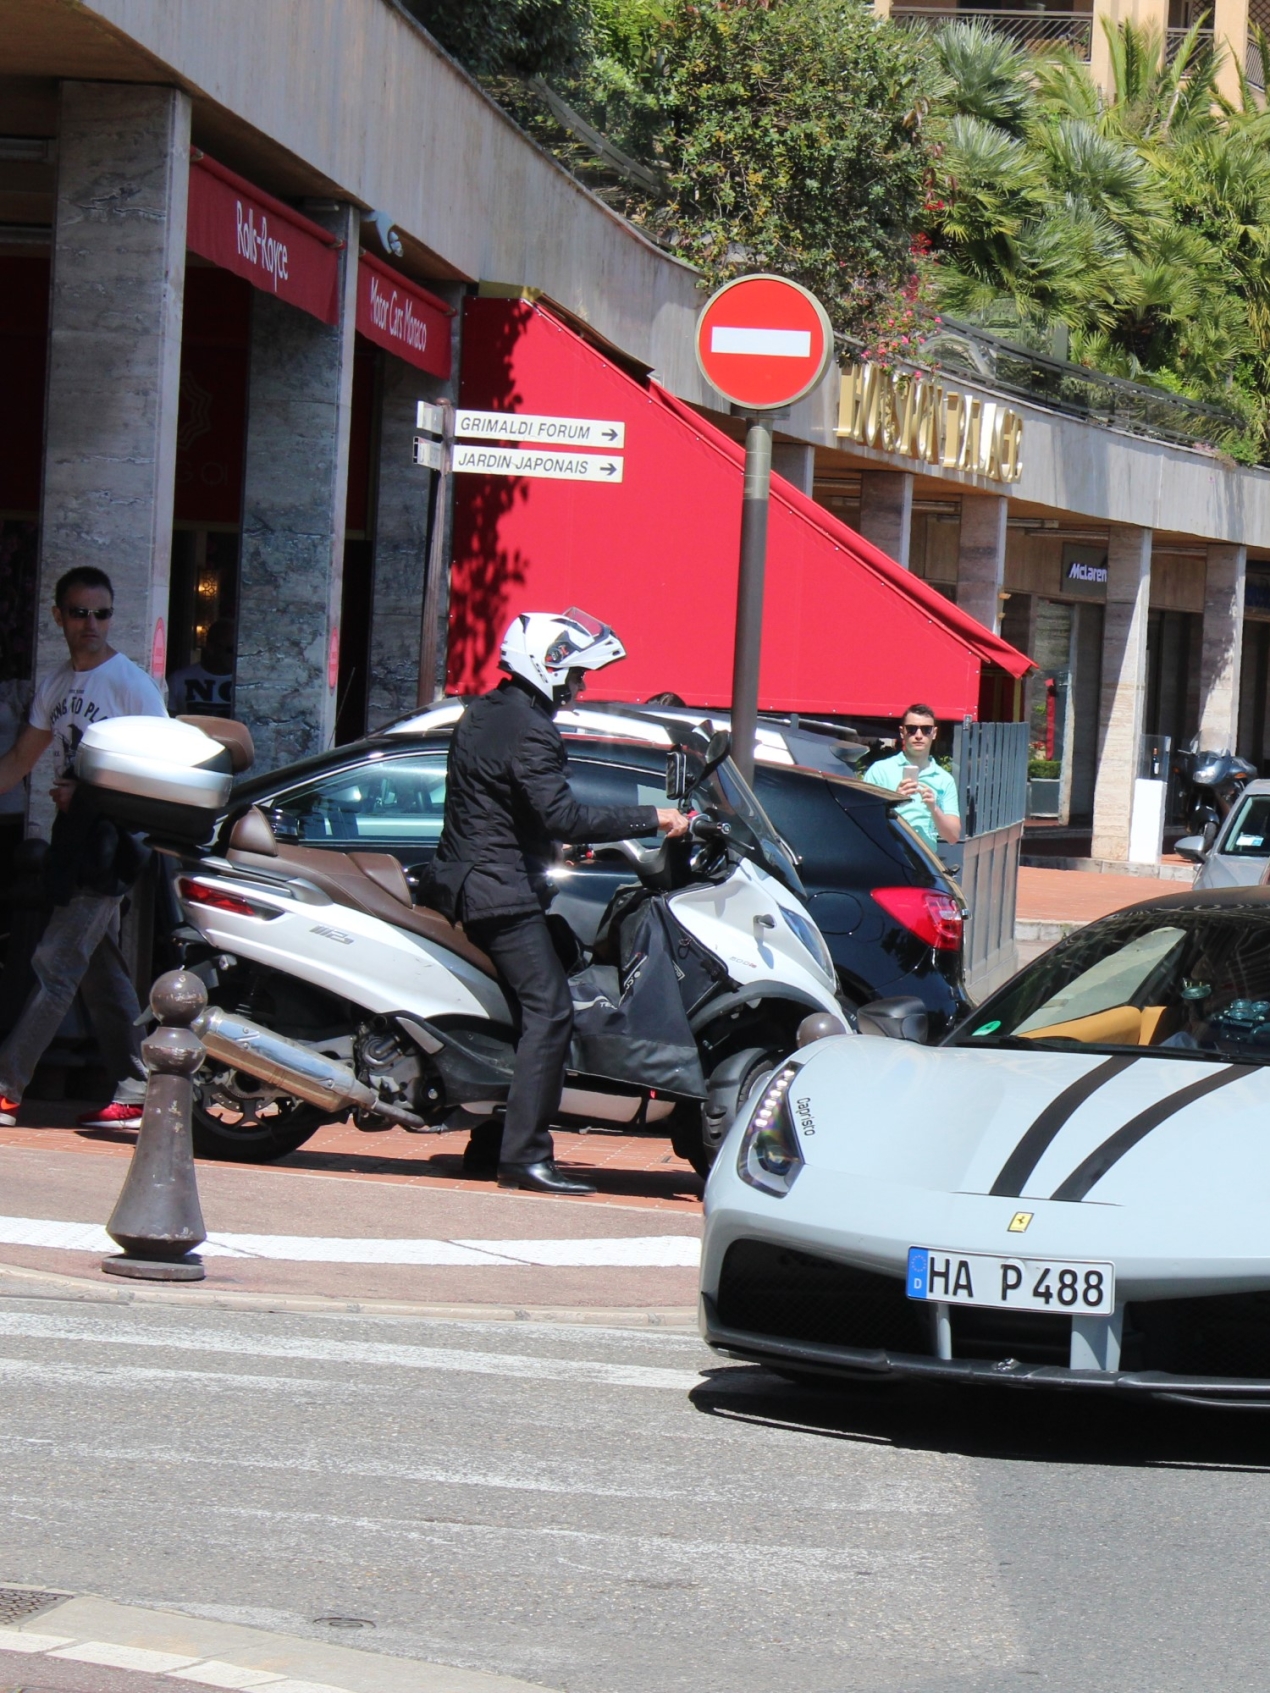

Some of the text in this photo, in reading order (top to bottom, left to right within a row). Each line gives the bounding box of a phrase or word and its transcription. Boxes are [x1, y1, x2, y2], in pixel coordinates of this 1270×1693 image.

[236, 200, 289, 292] Rolls-Royce
[370, 277, 427, 352] Motor Cars Monaco
[460, 416, 591, 440] GRIMALDI FORUM
[458, 452, 589, 474] JARDIN JAPONAIS
[1068, 562, 1107, 582] McLaren
[797, 1097, 816, 1137] Capristo
[928, 1256, 974, 1298] HA
